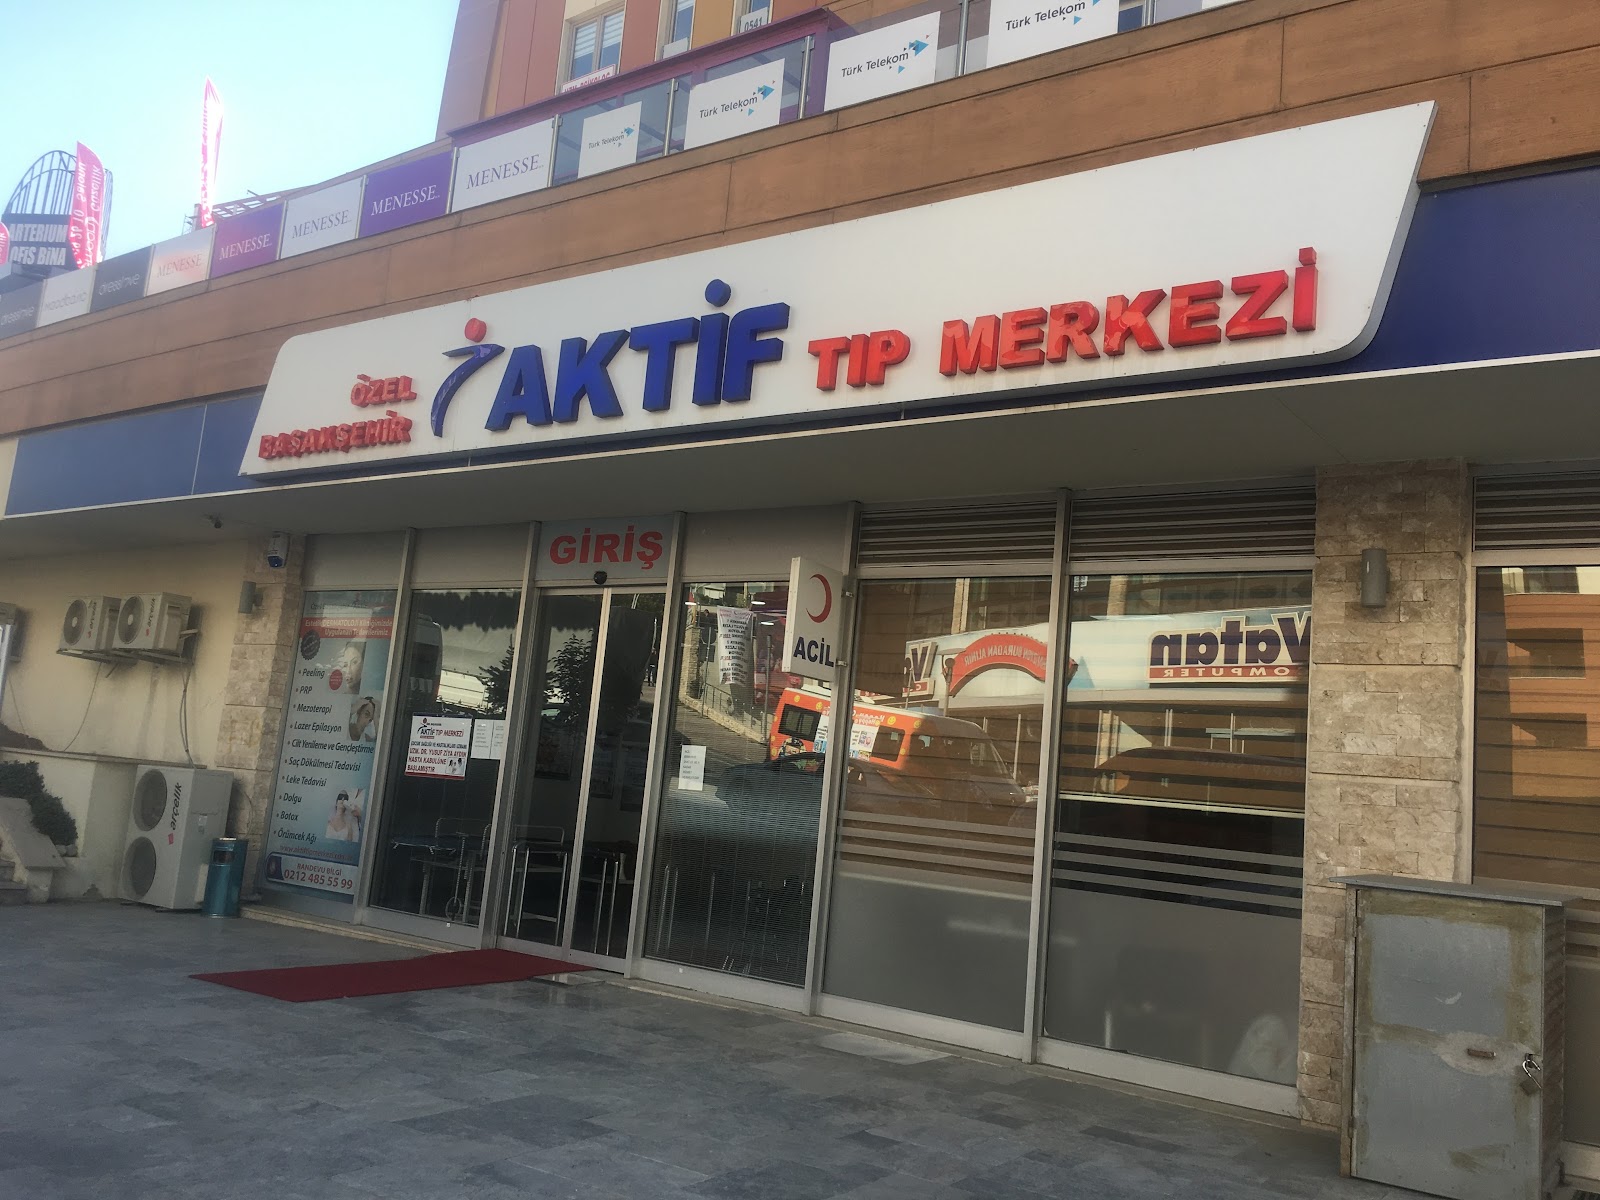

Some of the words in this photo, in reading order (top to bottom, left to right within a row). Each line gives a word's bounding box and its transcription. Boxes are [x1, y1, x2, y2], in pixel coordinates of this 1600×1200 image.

[1005, 16, 1031, 31] Türk
[1035, 1, 1086, 23] Telekom
[841, 63, 863, 78] Türk
[866, 50, 909, 71] Telekom
[699, 105, 718, 119] Türk
[721, 95, 758, 113] Telekom
[601, 134, 624, 146] Telekom
[466, 154, 540, 190] MENESSE
[371, 184, 437, 216] MENESSE
[291, 209, 350, 240] MENESSE
[219, 233, 271, 260] MENESSE
[157, 253, 202, 278] MENESSE
[485, 278, 790, 432] AKTİF
[808, 329, 910, 391] TIP
[939, 247, 1318, 376] MERKEZİ
[350, 374, 417, 408] ÖZEL
[258, 410, 413, 460] BAŞAKŞEHİR
[550, 525, 663, 570] GİRİŞ
[793, 637, 835, 668] ACİL
[302, 668, 325, 680] Peeling
[299, 685, 313, 695] PRP
[297, 703, 332, 715] Mezoterapi
[294, 722, 312, 731] Lazer
[312, 723, 342, 734] Epilasyon
[302, 739, 327, 750] Yenileme
[289, 757, 300, 767] Saç
[301, 758, 334, 769] Dökülmesi
[335, 760, 361, 772] Tedavisi
[286, 775, 301, 785] Leke
[301, 776, 326, 787] Tedavisi
[170, 782, 183, 831] arçelik
[283, 793, 302, 804] Dolgu
[281, 811, 299, 821] Botox
[278, 828, 305, 841] Örümcek
[306, 833, 317, 844] Ağı
[284, 869, 306, 881] 0212
[308, 873, 325, 884] 485
[326, 876, 339, 887] 55
[340, 878, 353, 889] 99
[297, 863, 326, 873] RANDEVU
[326, 866, 342, 876] BİLGİ
